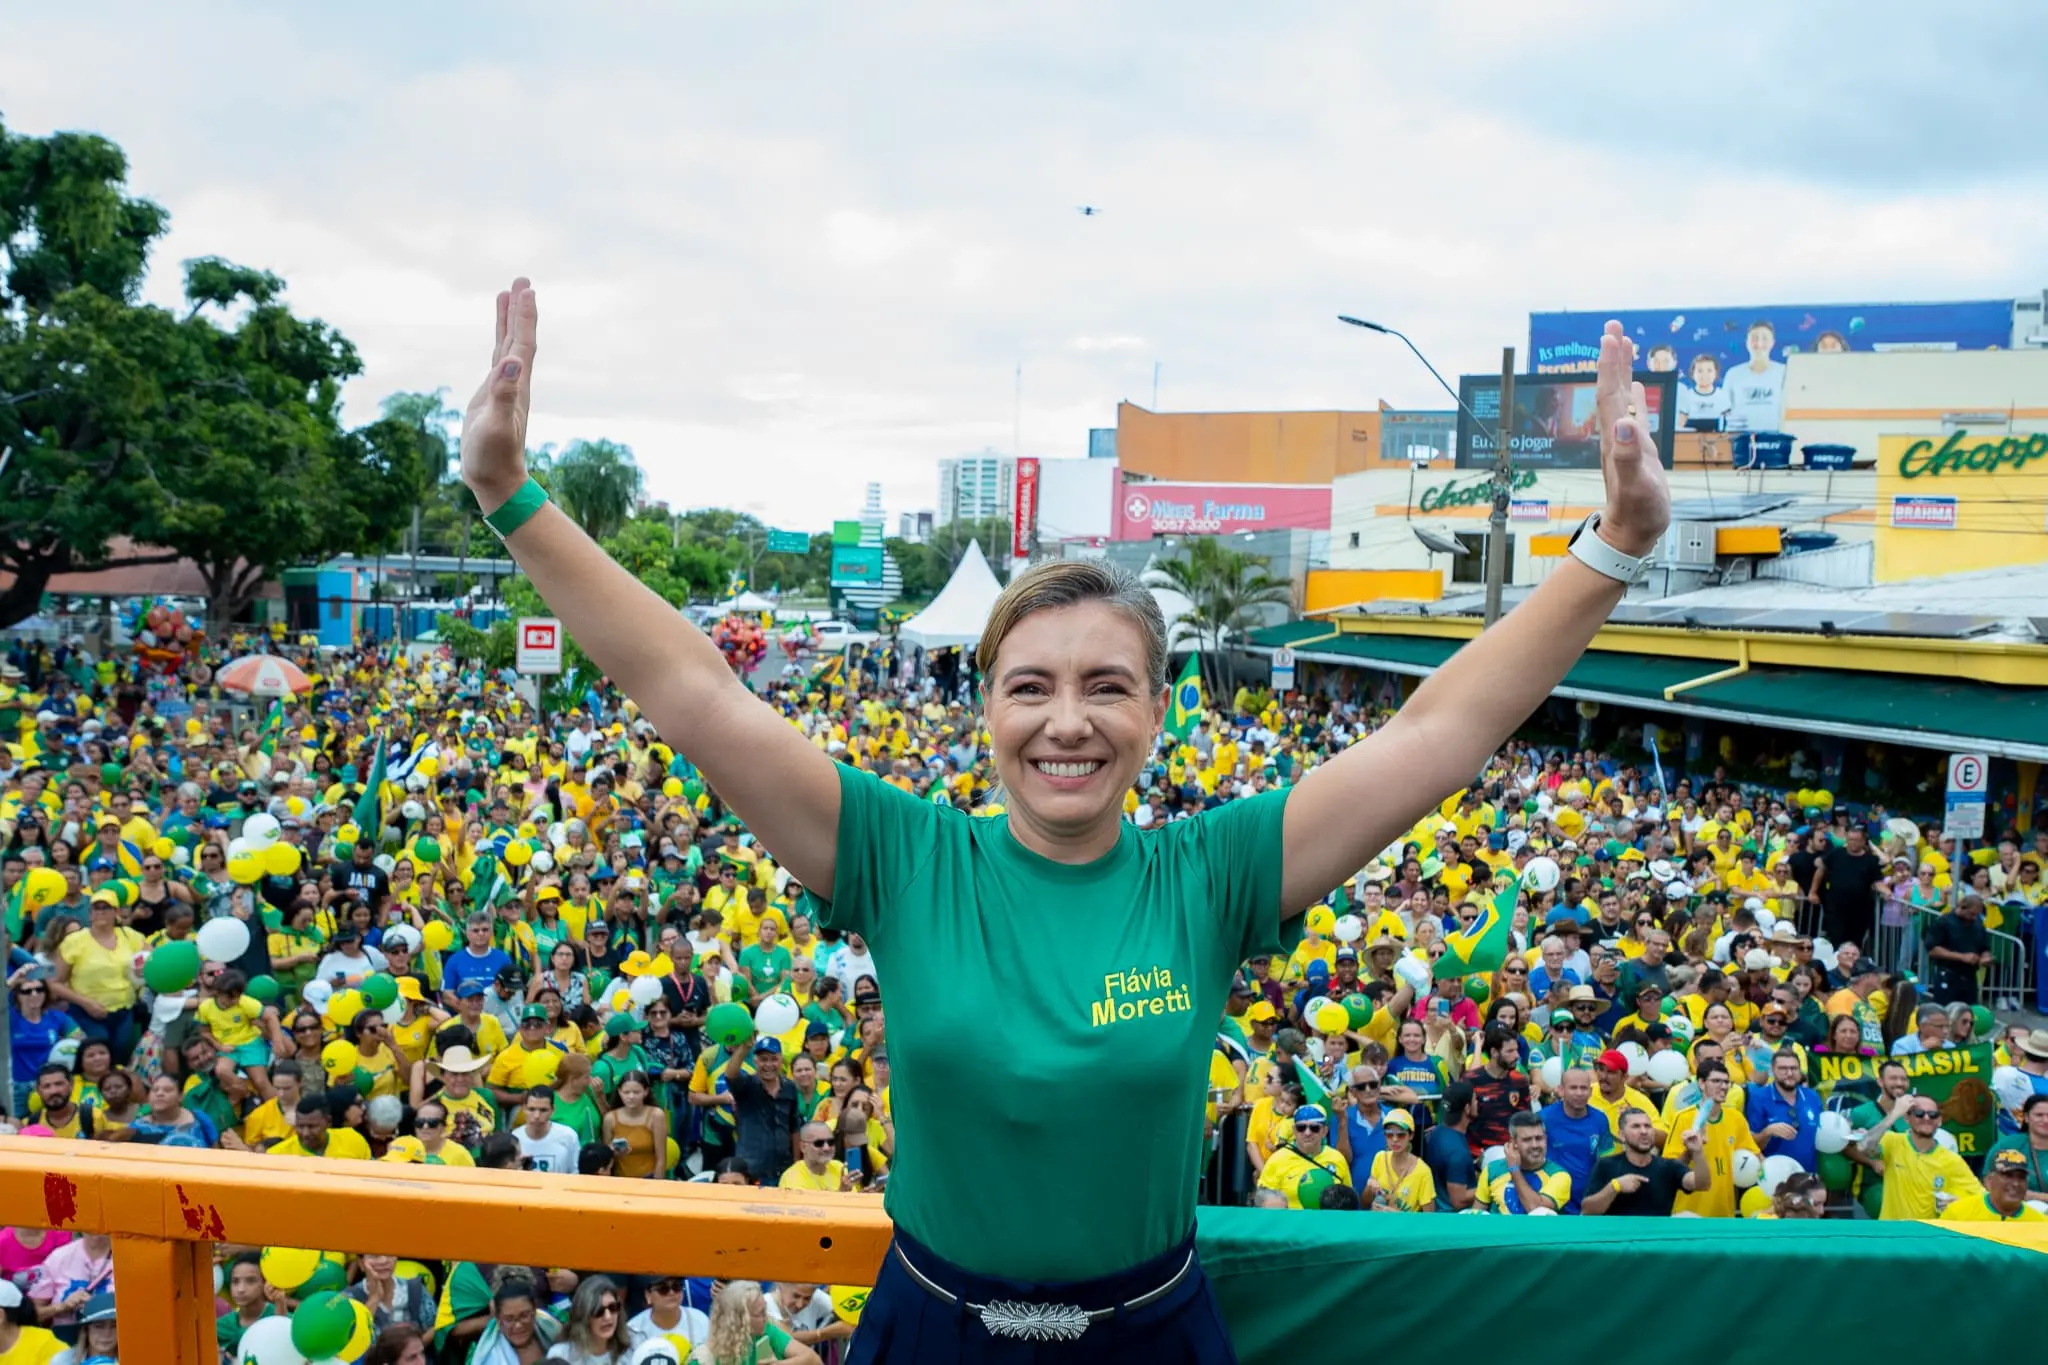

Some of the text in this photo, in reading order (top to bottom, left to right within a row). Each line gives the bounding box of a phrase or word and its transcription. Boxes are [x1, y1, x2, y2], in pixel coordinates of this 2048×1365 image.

[1539, 341, 1601, 361] As melhore
[1472, 434, 1488, 449] Eu
[1520, 434, 1554, 452] jogar
[1203, 498, 1265, 521] Farma
[1963, 764, 1975, 784] E
[1104, 965, 1172, 998] Flávia
[1091, 983, 1192, 1028] Moretti
[1819, 1055, 1863, 1081] NO
